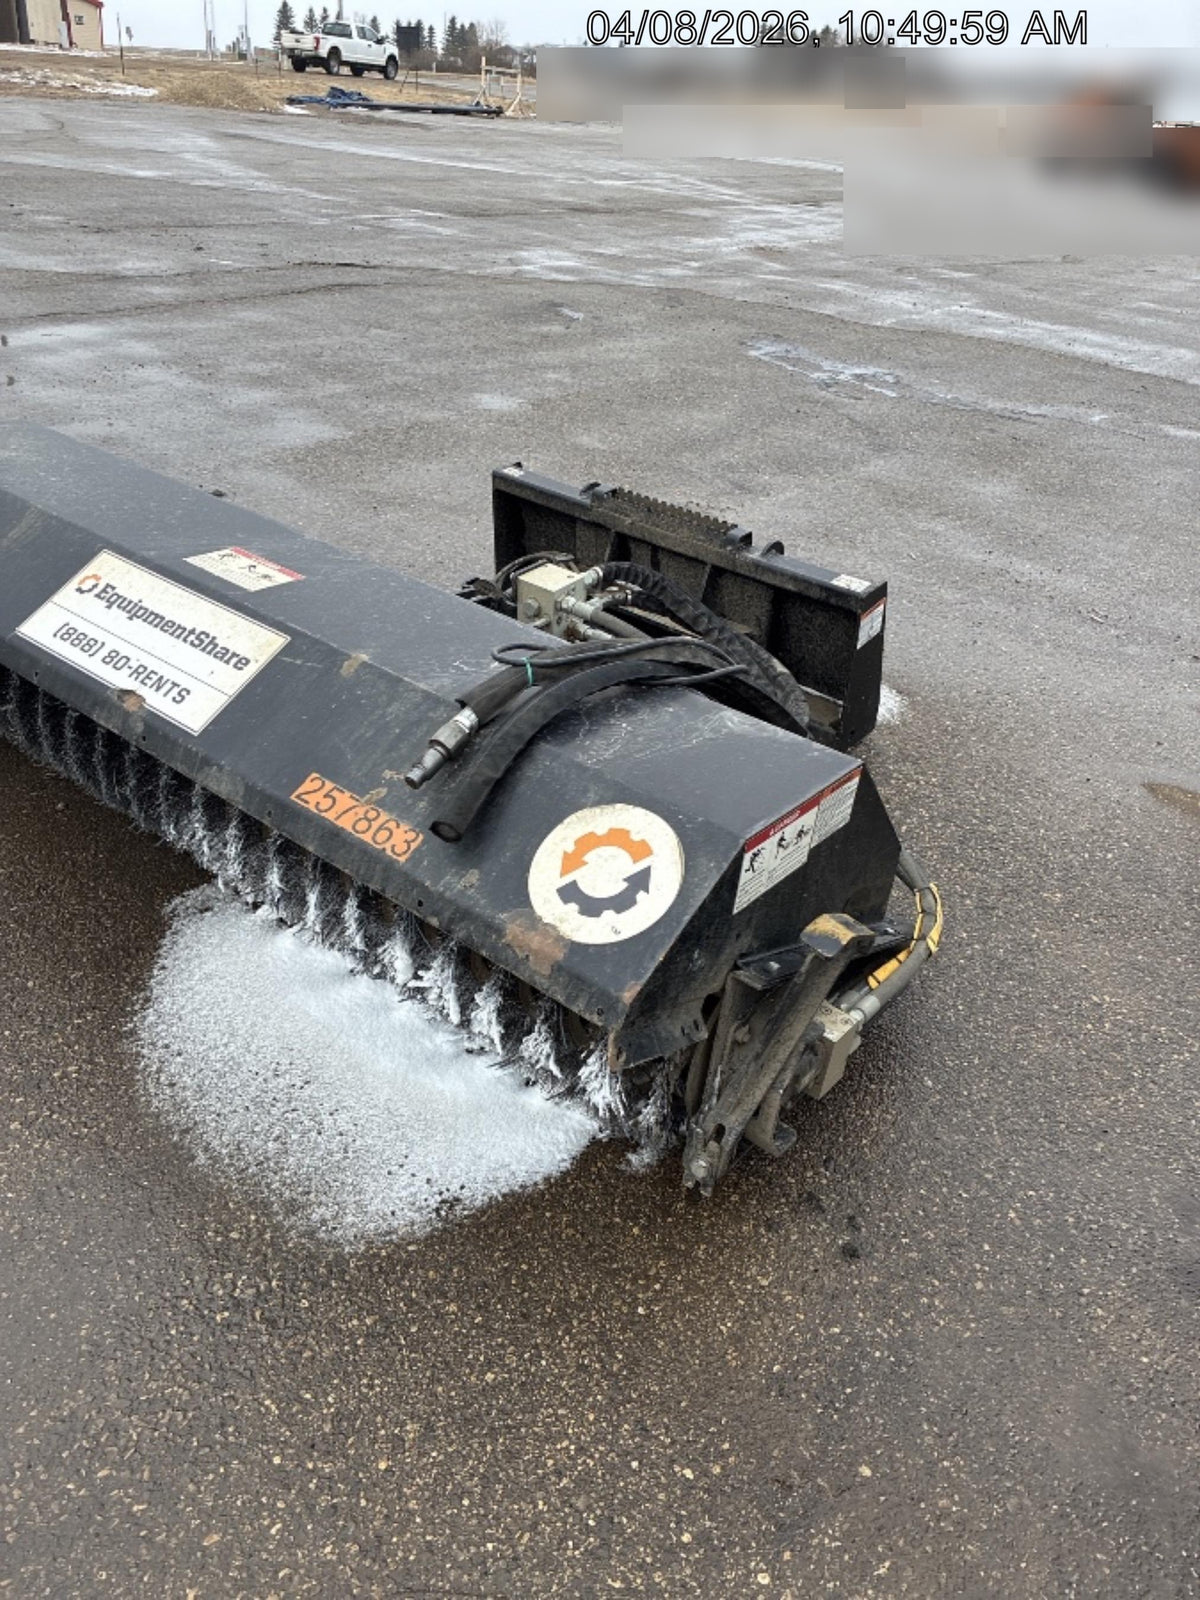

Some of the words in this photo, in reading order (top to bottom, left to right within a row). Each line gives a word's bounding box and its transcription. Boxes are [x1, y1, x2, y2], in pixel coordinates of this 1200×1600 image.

[52, 621, 105, 658] (888)
[101, 648, 191, 705] 80-RENTS
[94, 582, 251, 672] EquipmentShare
[294, 776, 420, 857] 257863
